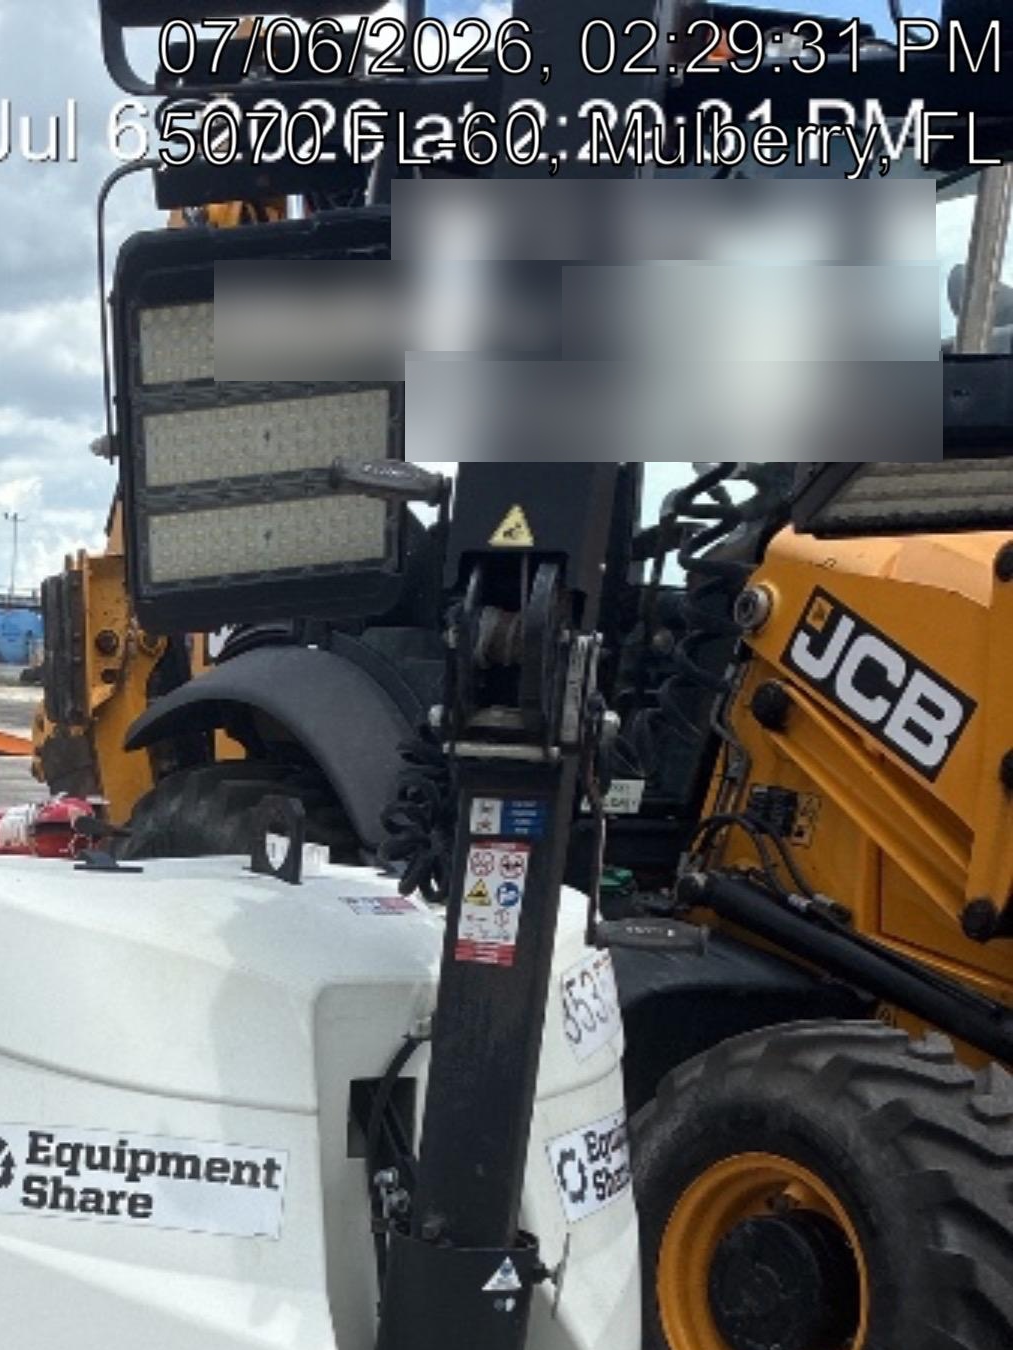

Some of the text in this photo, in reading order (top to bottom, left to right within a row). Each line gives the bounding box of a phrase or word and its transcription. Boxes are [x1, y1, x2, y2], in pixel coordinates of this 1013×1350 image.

[789, 613, 964, 768] JCB
[25, 1130, 282, 1190] Equipment
[20, 1174, 153, 1218] Share
